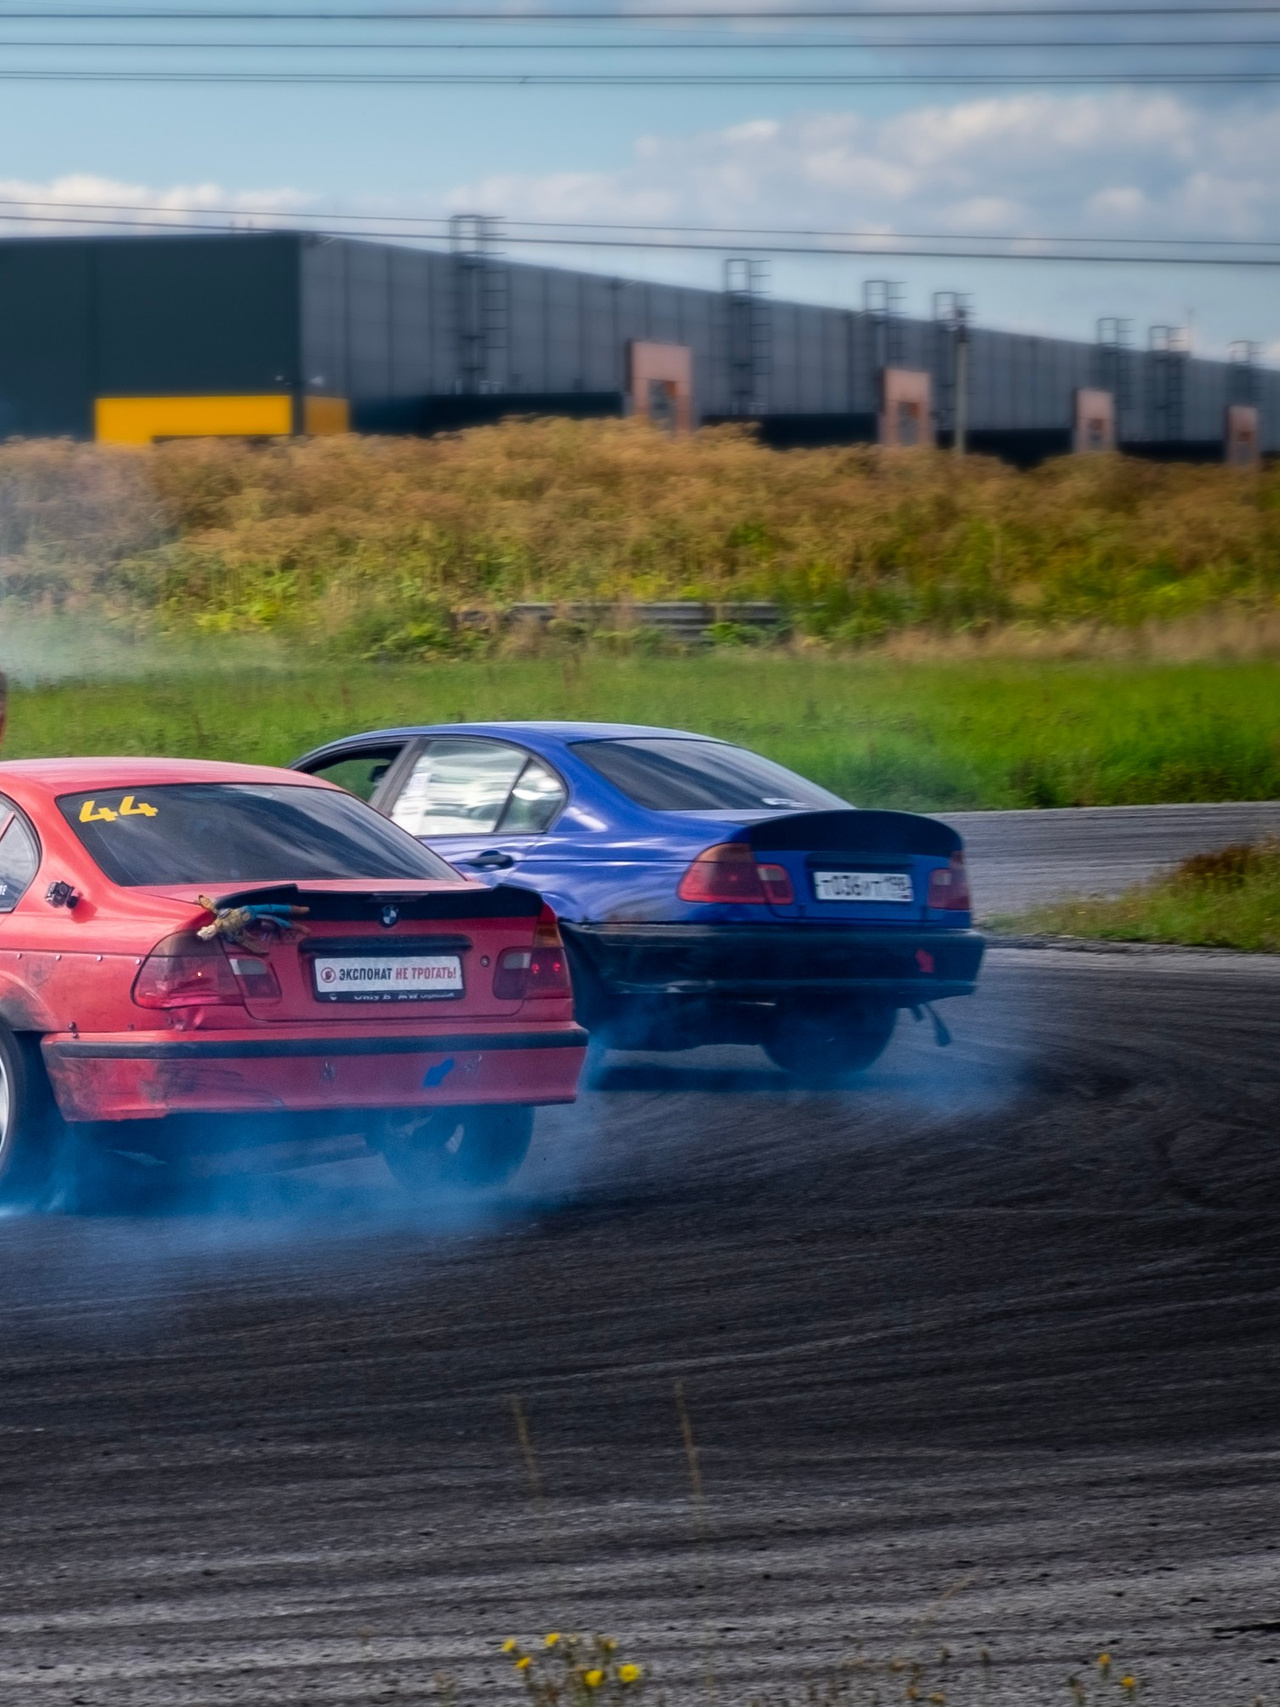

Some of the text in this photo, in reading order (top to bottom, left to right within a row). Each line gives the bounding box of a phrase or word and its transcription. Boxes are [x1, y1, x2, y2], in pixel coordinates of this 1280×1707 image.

[79, 795, 158, 823] 44
[339, 966, 457, 980] ЭКСПОНАТ НЕ ТРОГАТЬ!
